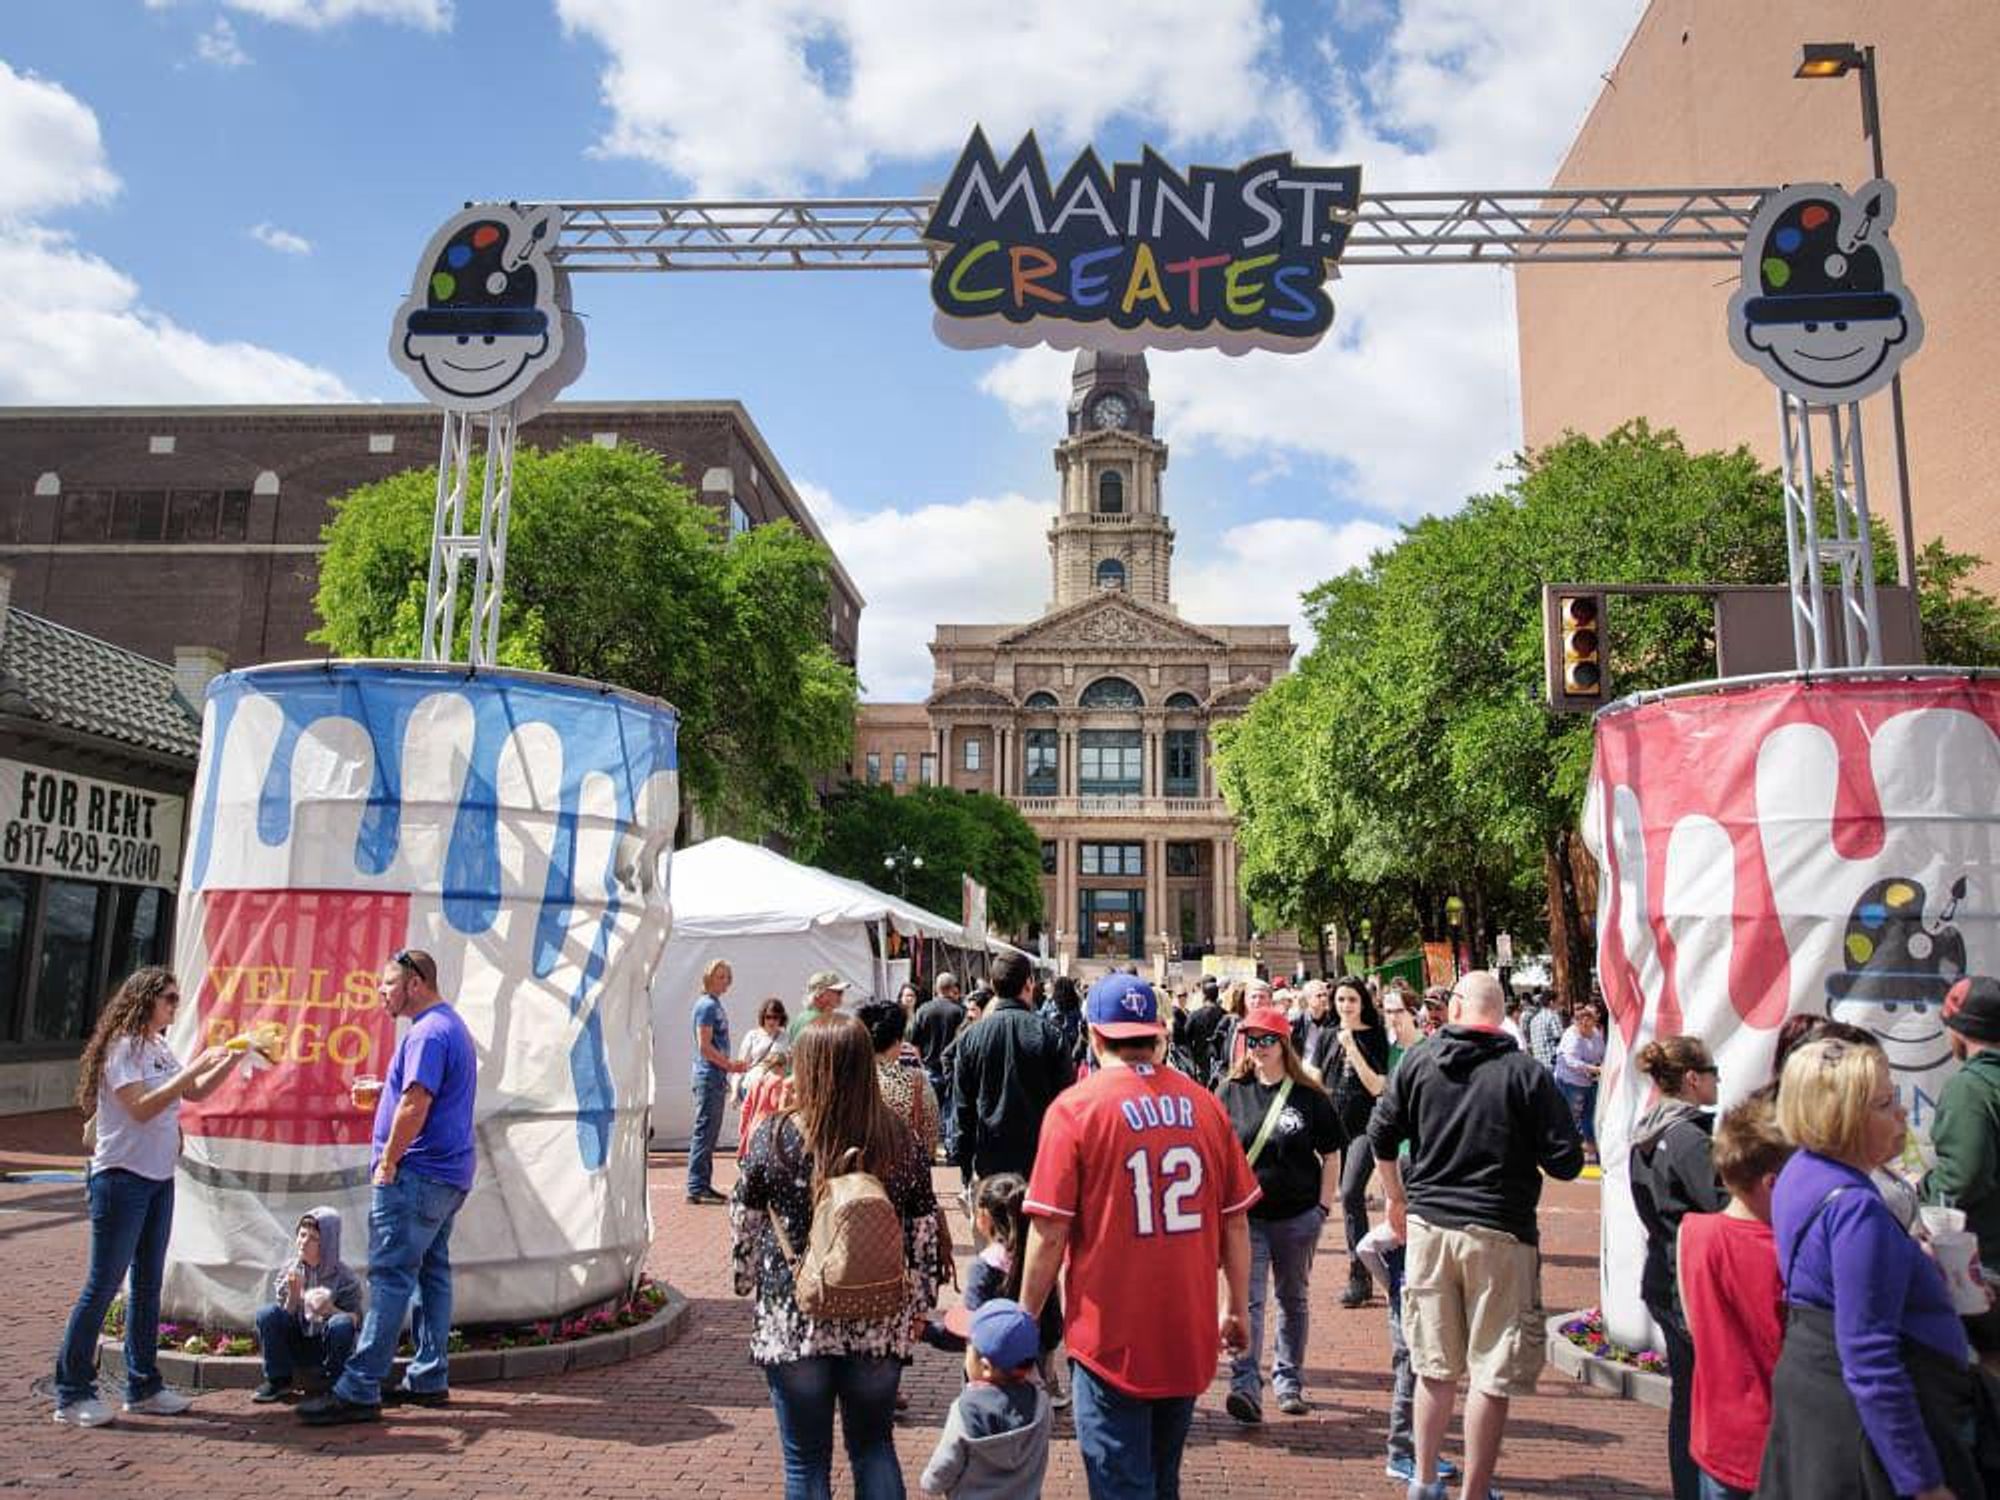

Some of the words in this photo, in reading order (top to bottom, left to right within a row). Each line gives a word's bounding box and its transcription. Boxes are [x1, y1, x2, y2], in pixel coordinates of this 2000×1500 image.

[948, 160, 1215, 242] MAIN
[1241, 169, 1343, 248] ST.
[948, 240, 1317, 322] CREATES
[20, 770, 78, 827] FOR
[88, 785, 157, 839] RENT
[3, 820, 161, 881] 817-429-2000
[1121, 1094, 1194, 1131] ODOR
[1126, 1147, 1204, 1235] 12
